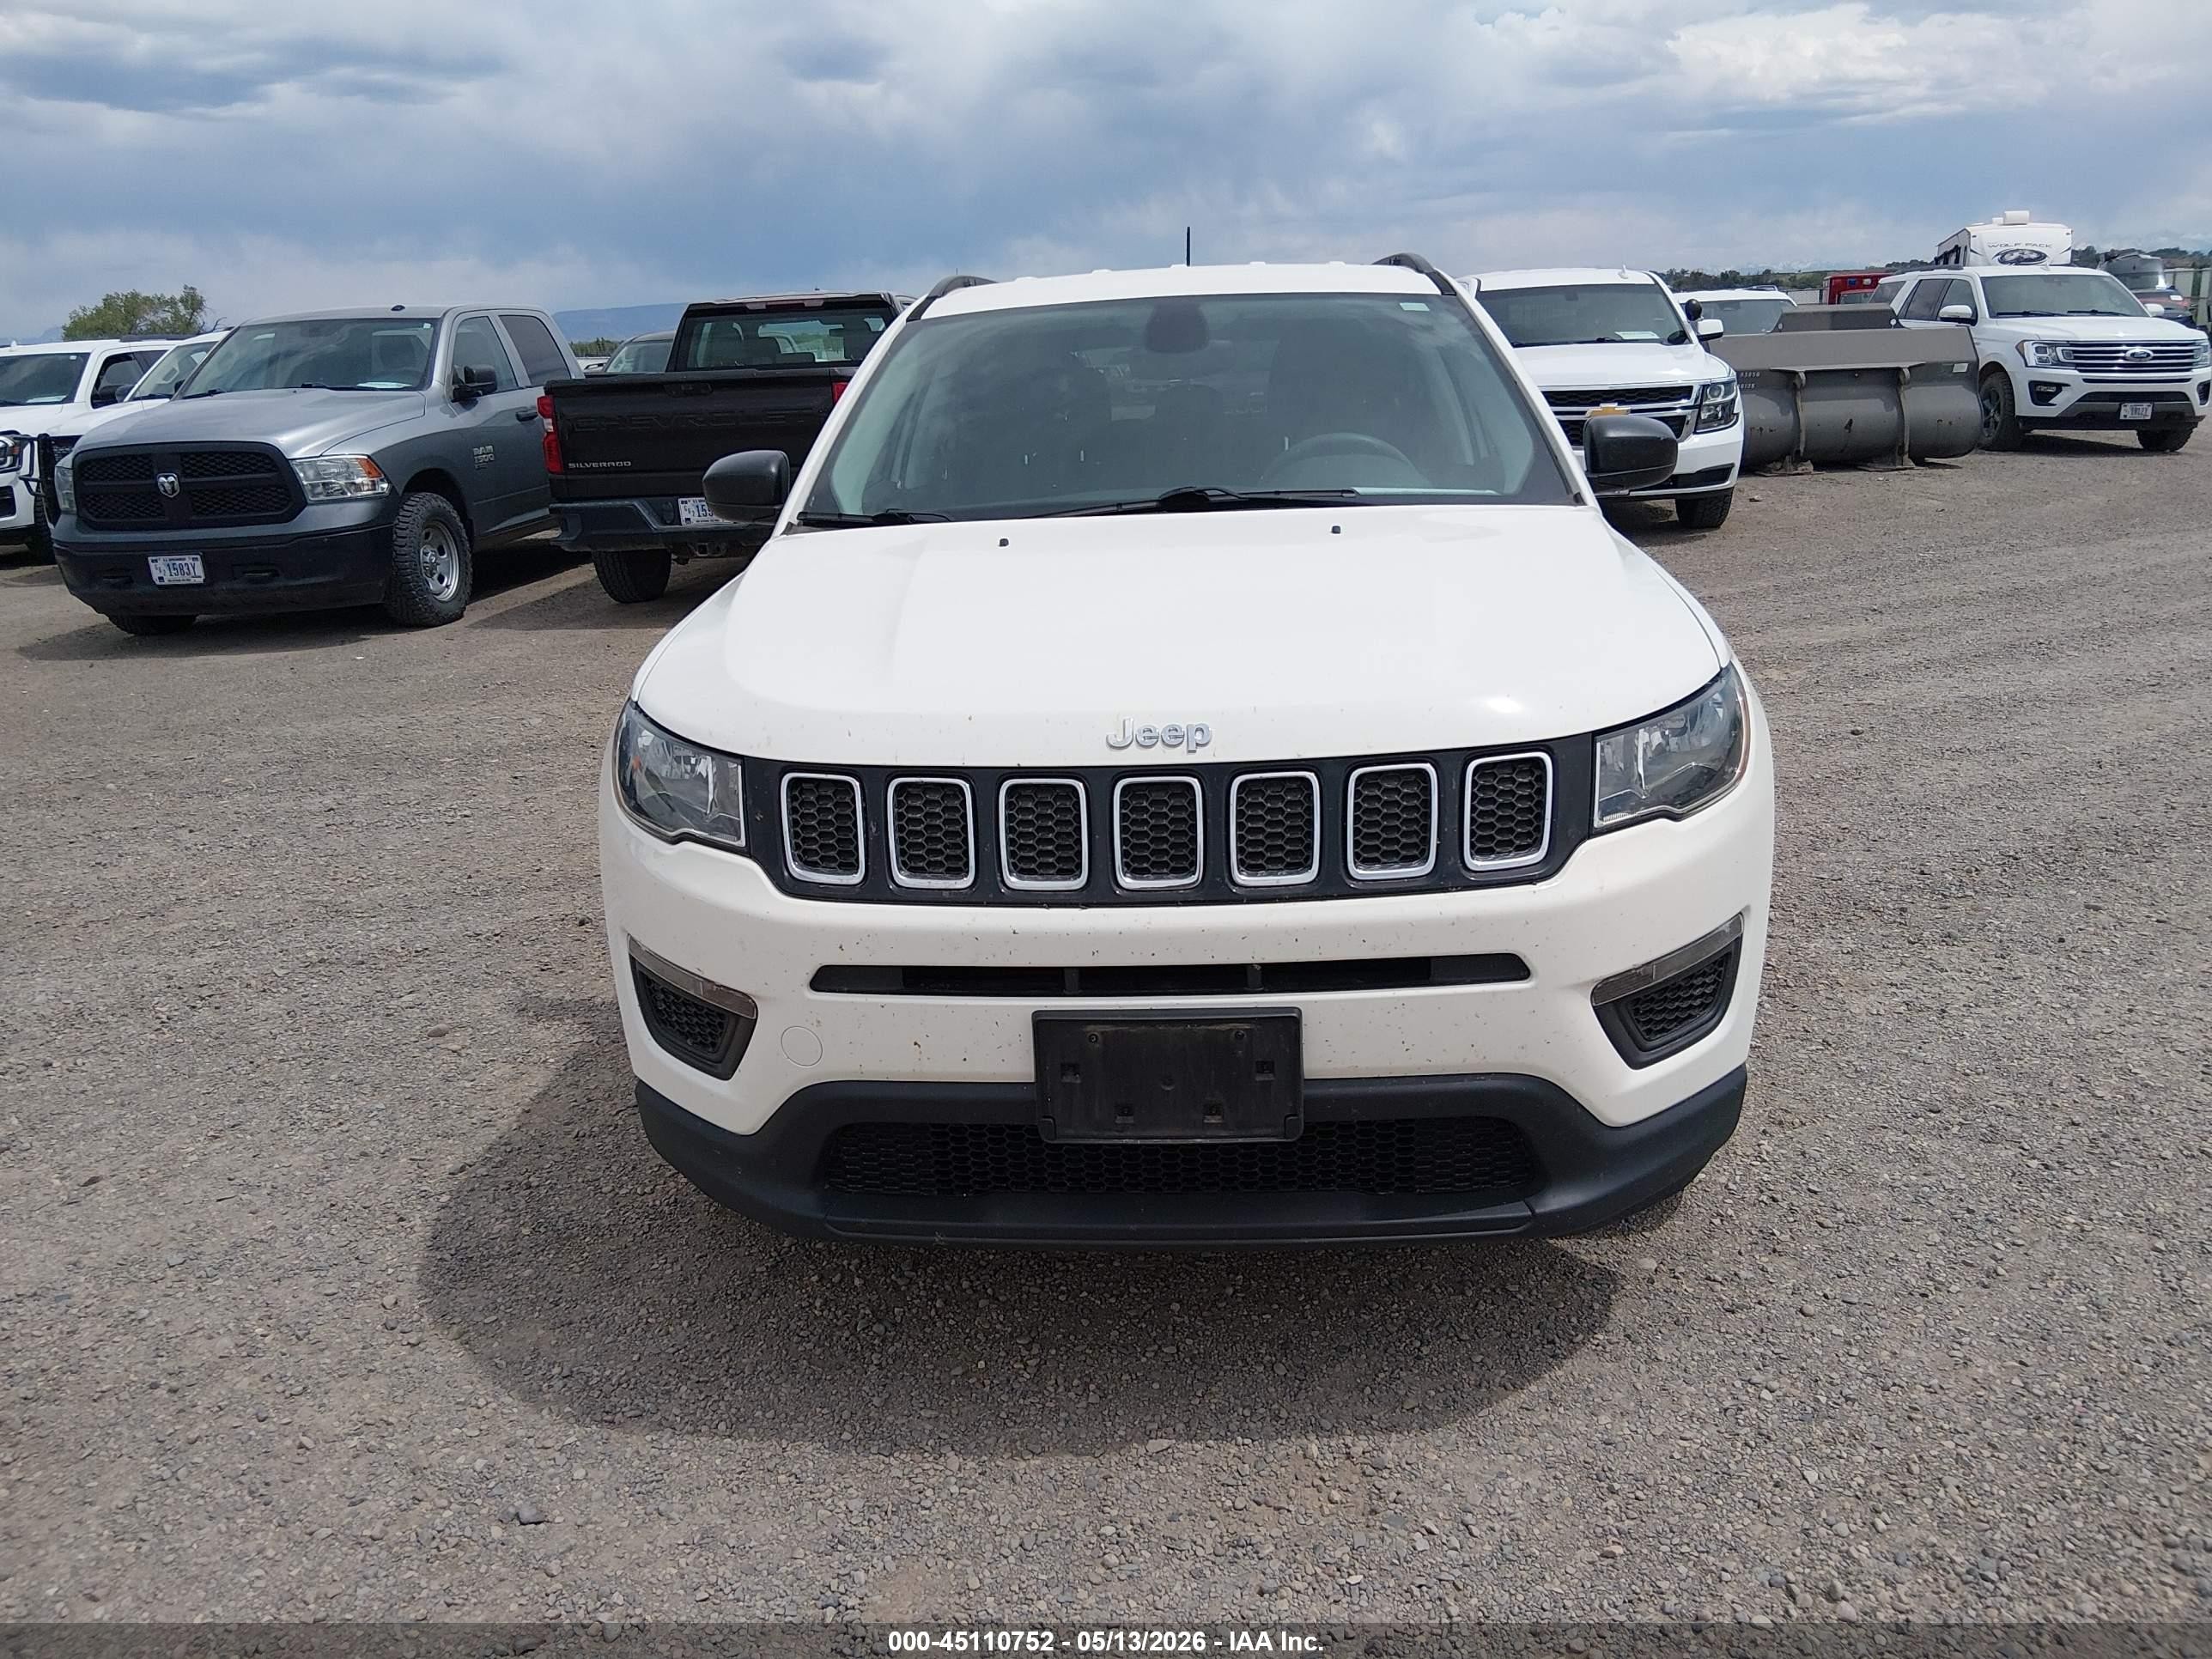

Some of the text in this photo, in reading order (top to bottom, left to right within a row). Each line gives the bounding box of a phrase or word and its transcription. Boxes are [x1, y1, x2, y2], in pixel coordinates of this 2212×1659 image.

[473, 445, 494, 455] RAM
[474, 453, 495, 463] 1500
[568, 460, 632, 469] SILVERADO
[167, 562, 197, 577] 1583Y
[1105, 718, 1212, 754] Jeep
